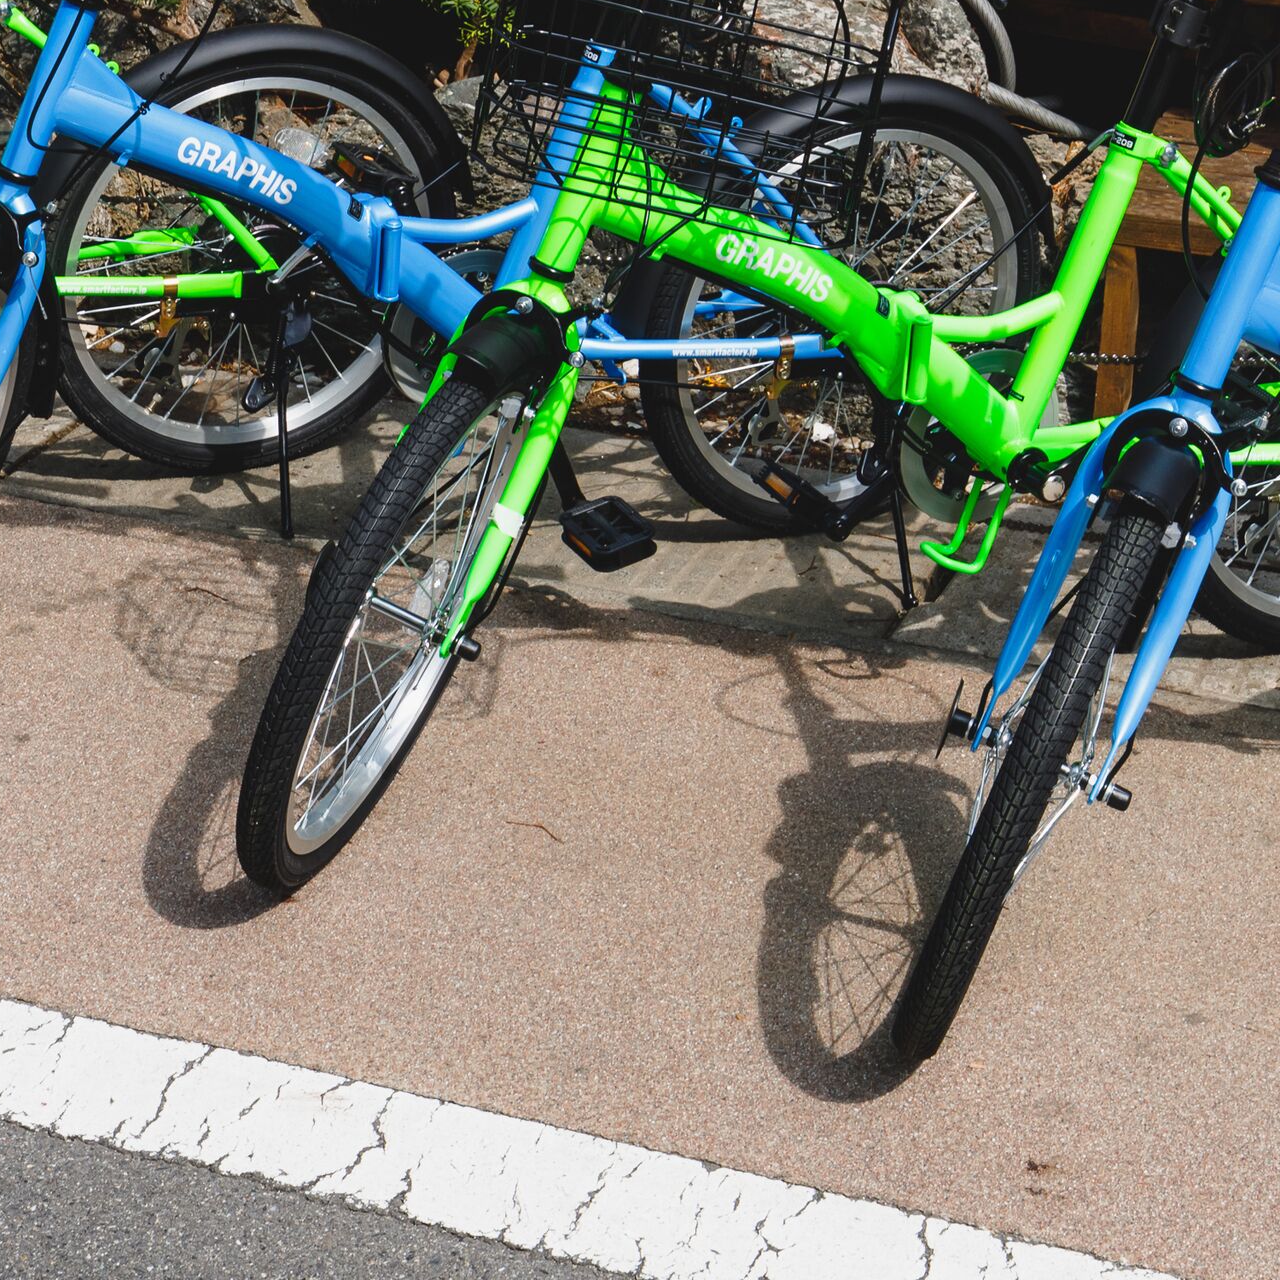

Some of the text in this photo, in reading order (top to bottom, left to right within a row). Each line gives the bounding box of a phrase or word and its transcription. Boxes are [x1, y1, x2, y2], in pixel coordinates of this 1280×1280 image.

[177, 136, 297, 205] GRAPHIS
[716, 233, 833, 302] GRAPHIS
[672, 347, 758, 357] www.smartfactory.jp
